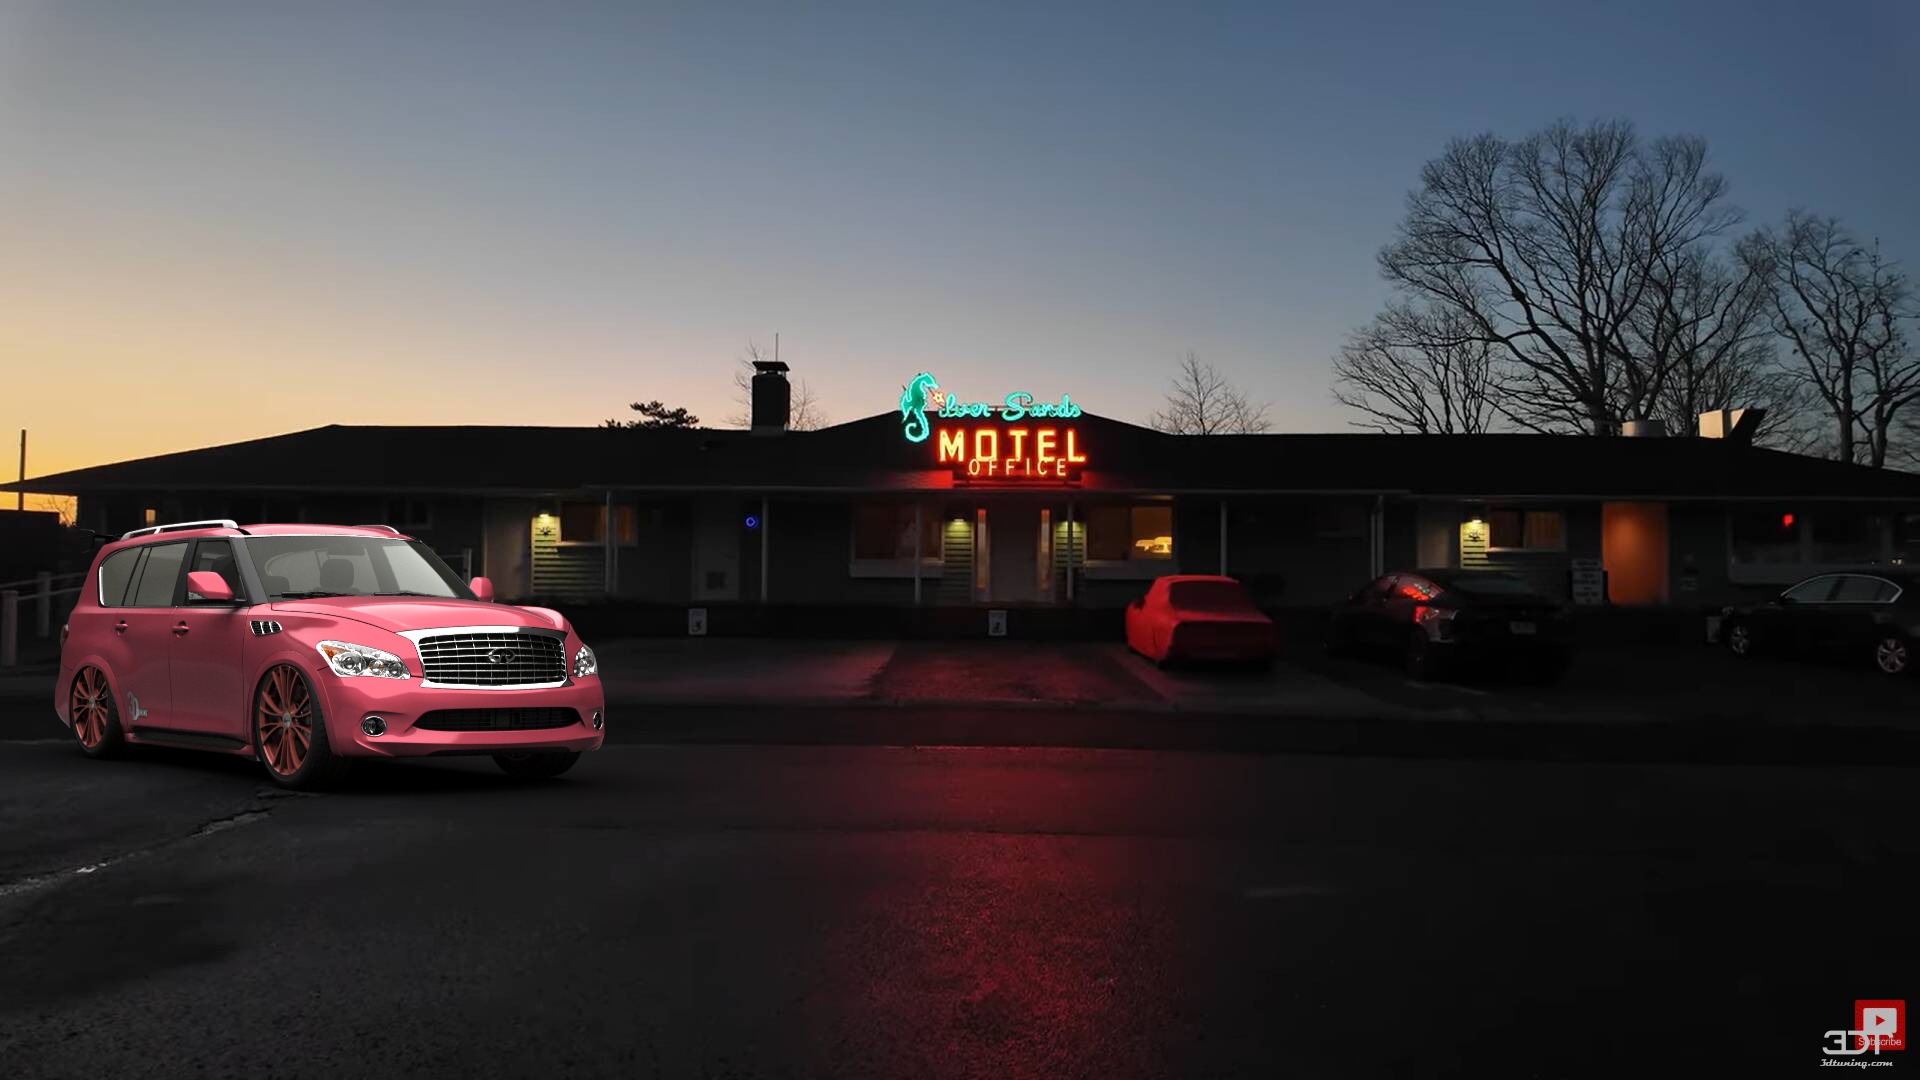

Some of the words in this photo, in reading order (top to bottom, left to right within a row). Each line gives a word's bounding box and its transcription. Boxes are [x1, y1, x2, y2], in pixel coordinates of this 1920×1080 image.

[1001, 391, 1081, 422] Sands
[939, 430, 1086, 462] MOTEL
[968, 458, 1066, 476] OFFICE
